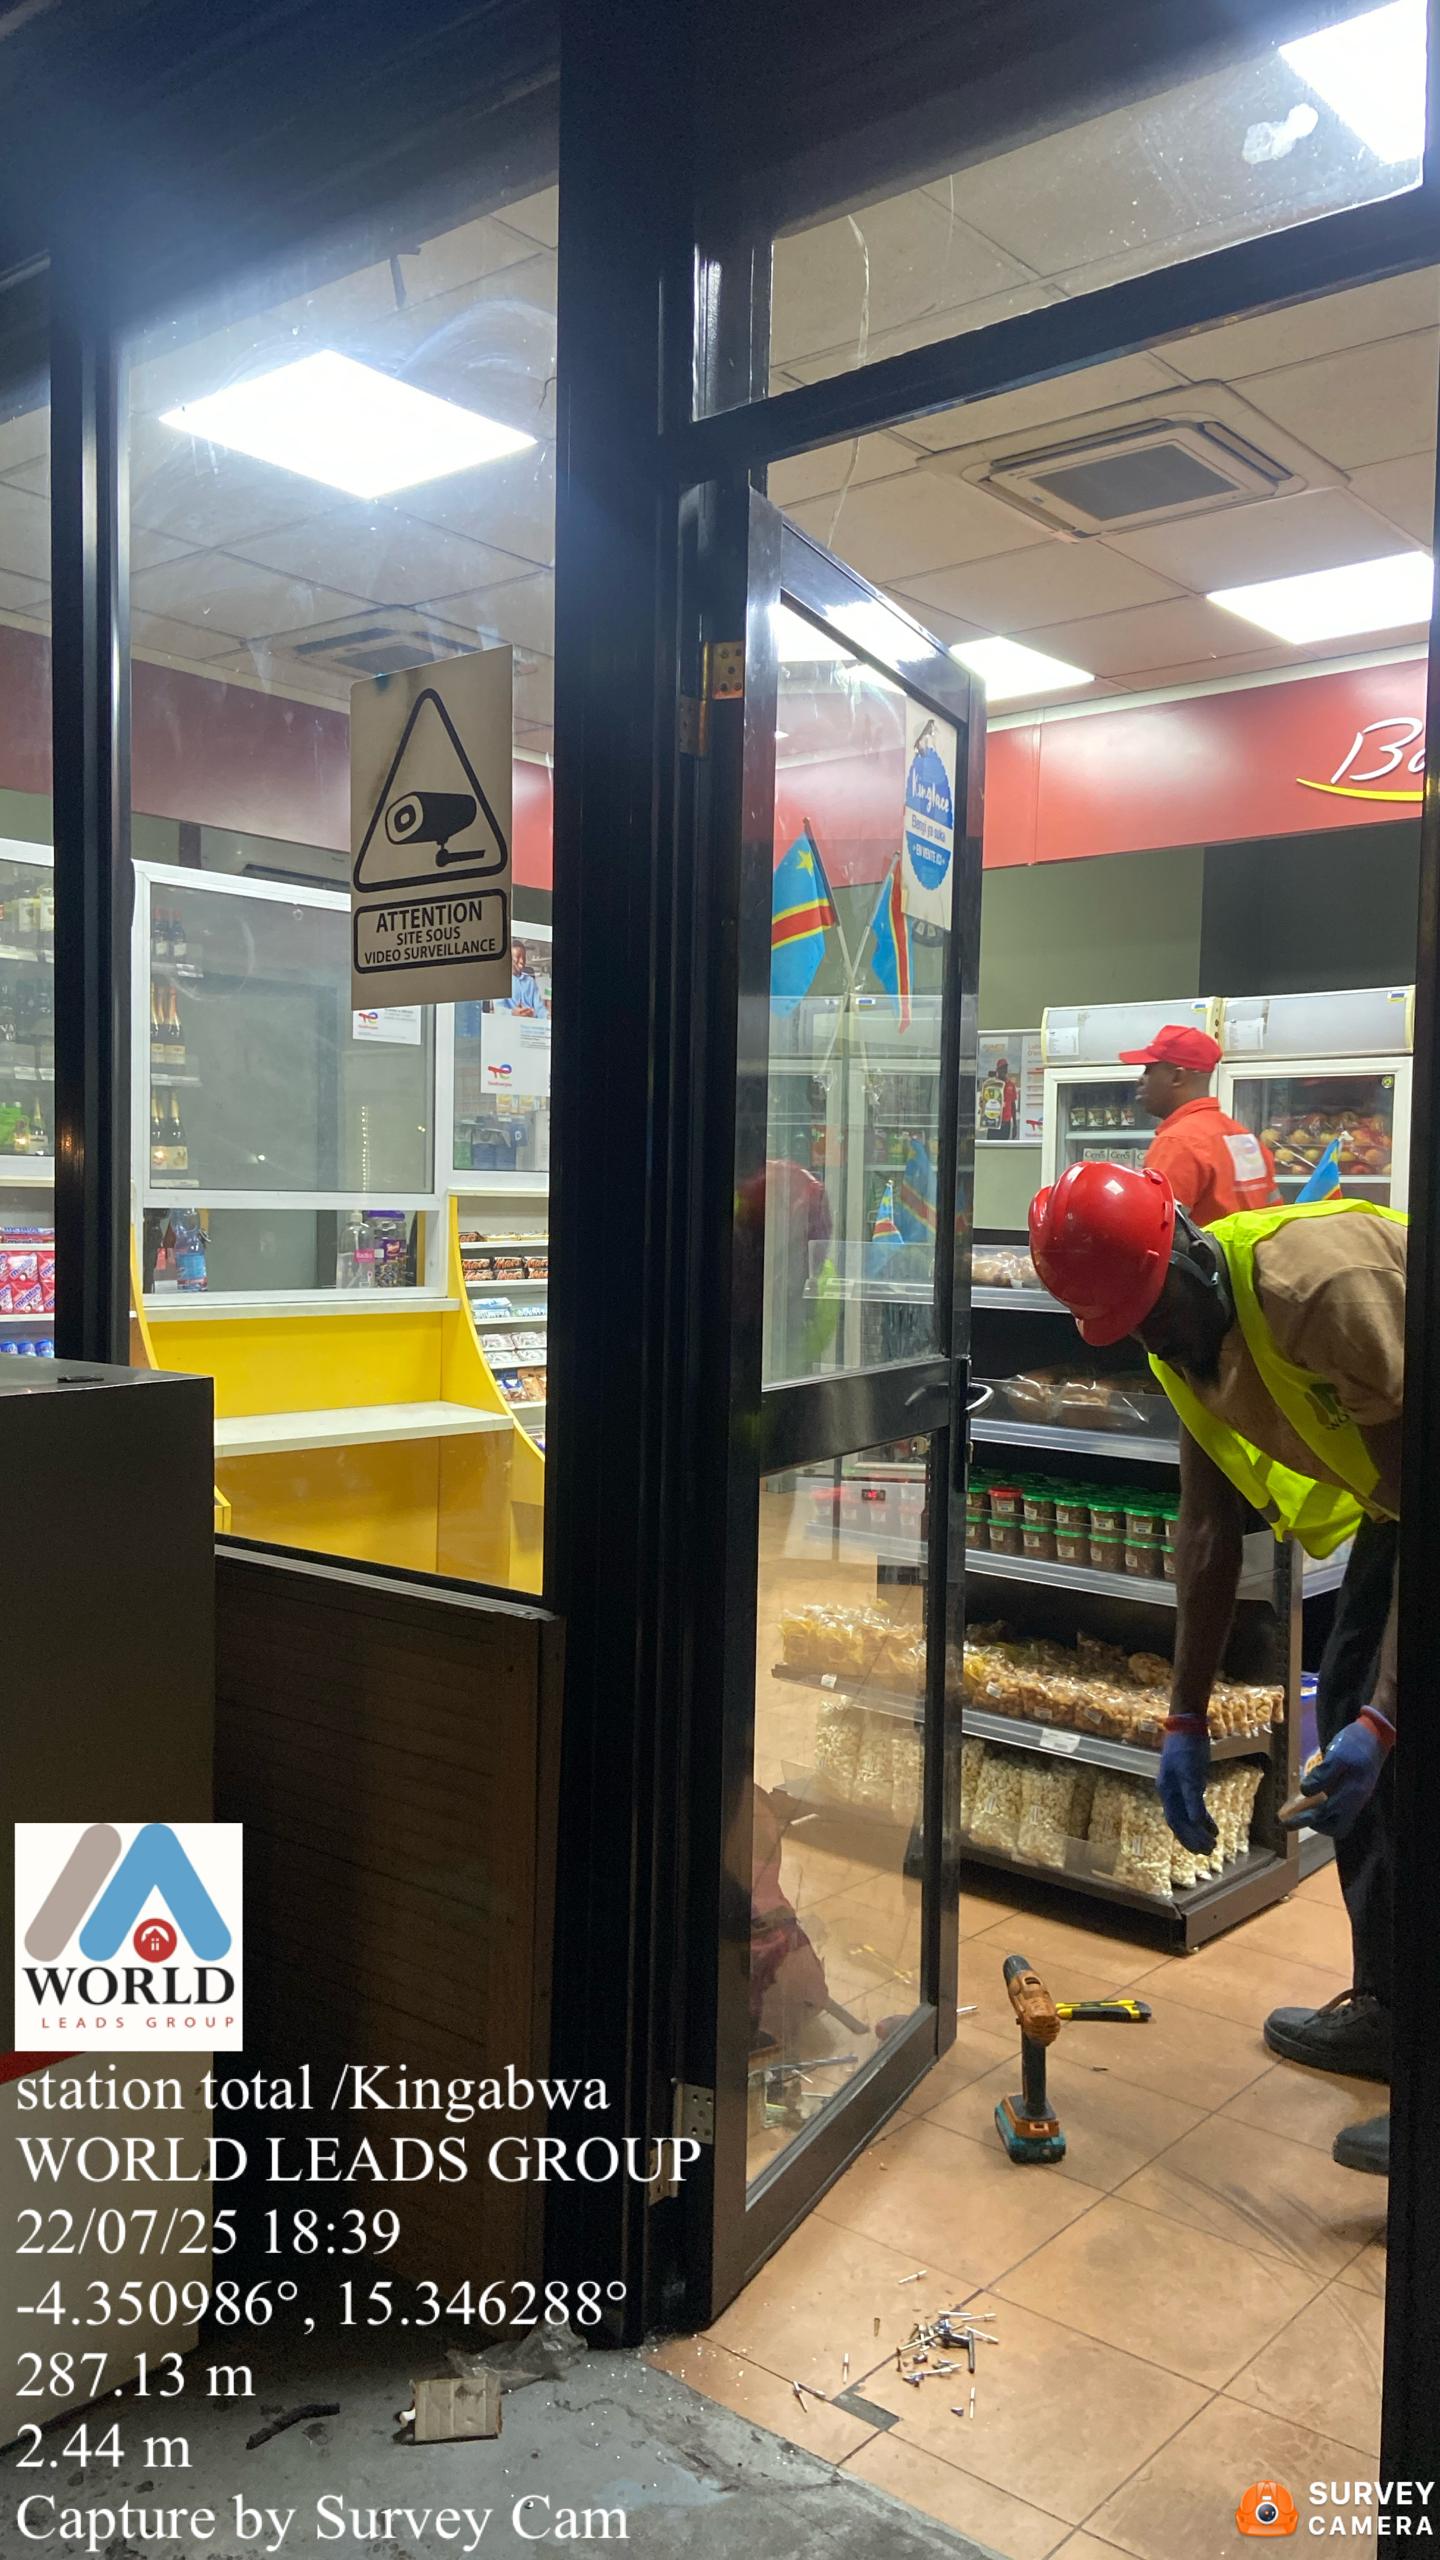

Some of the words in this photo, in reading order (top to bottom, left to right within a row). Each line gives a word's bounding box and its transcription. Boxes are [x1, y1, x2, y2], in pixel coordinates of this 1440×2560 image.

[376, 900, 482, 933] ATTENTION
[397, 930, 422, 946] SITE
[426, 926, 460, 943] SOUS
[365, 949, 401, 964] VIDEO
[404, 938, 496, 960] SURVEILLANCE
